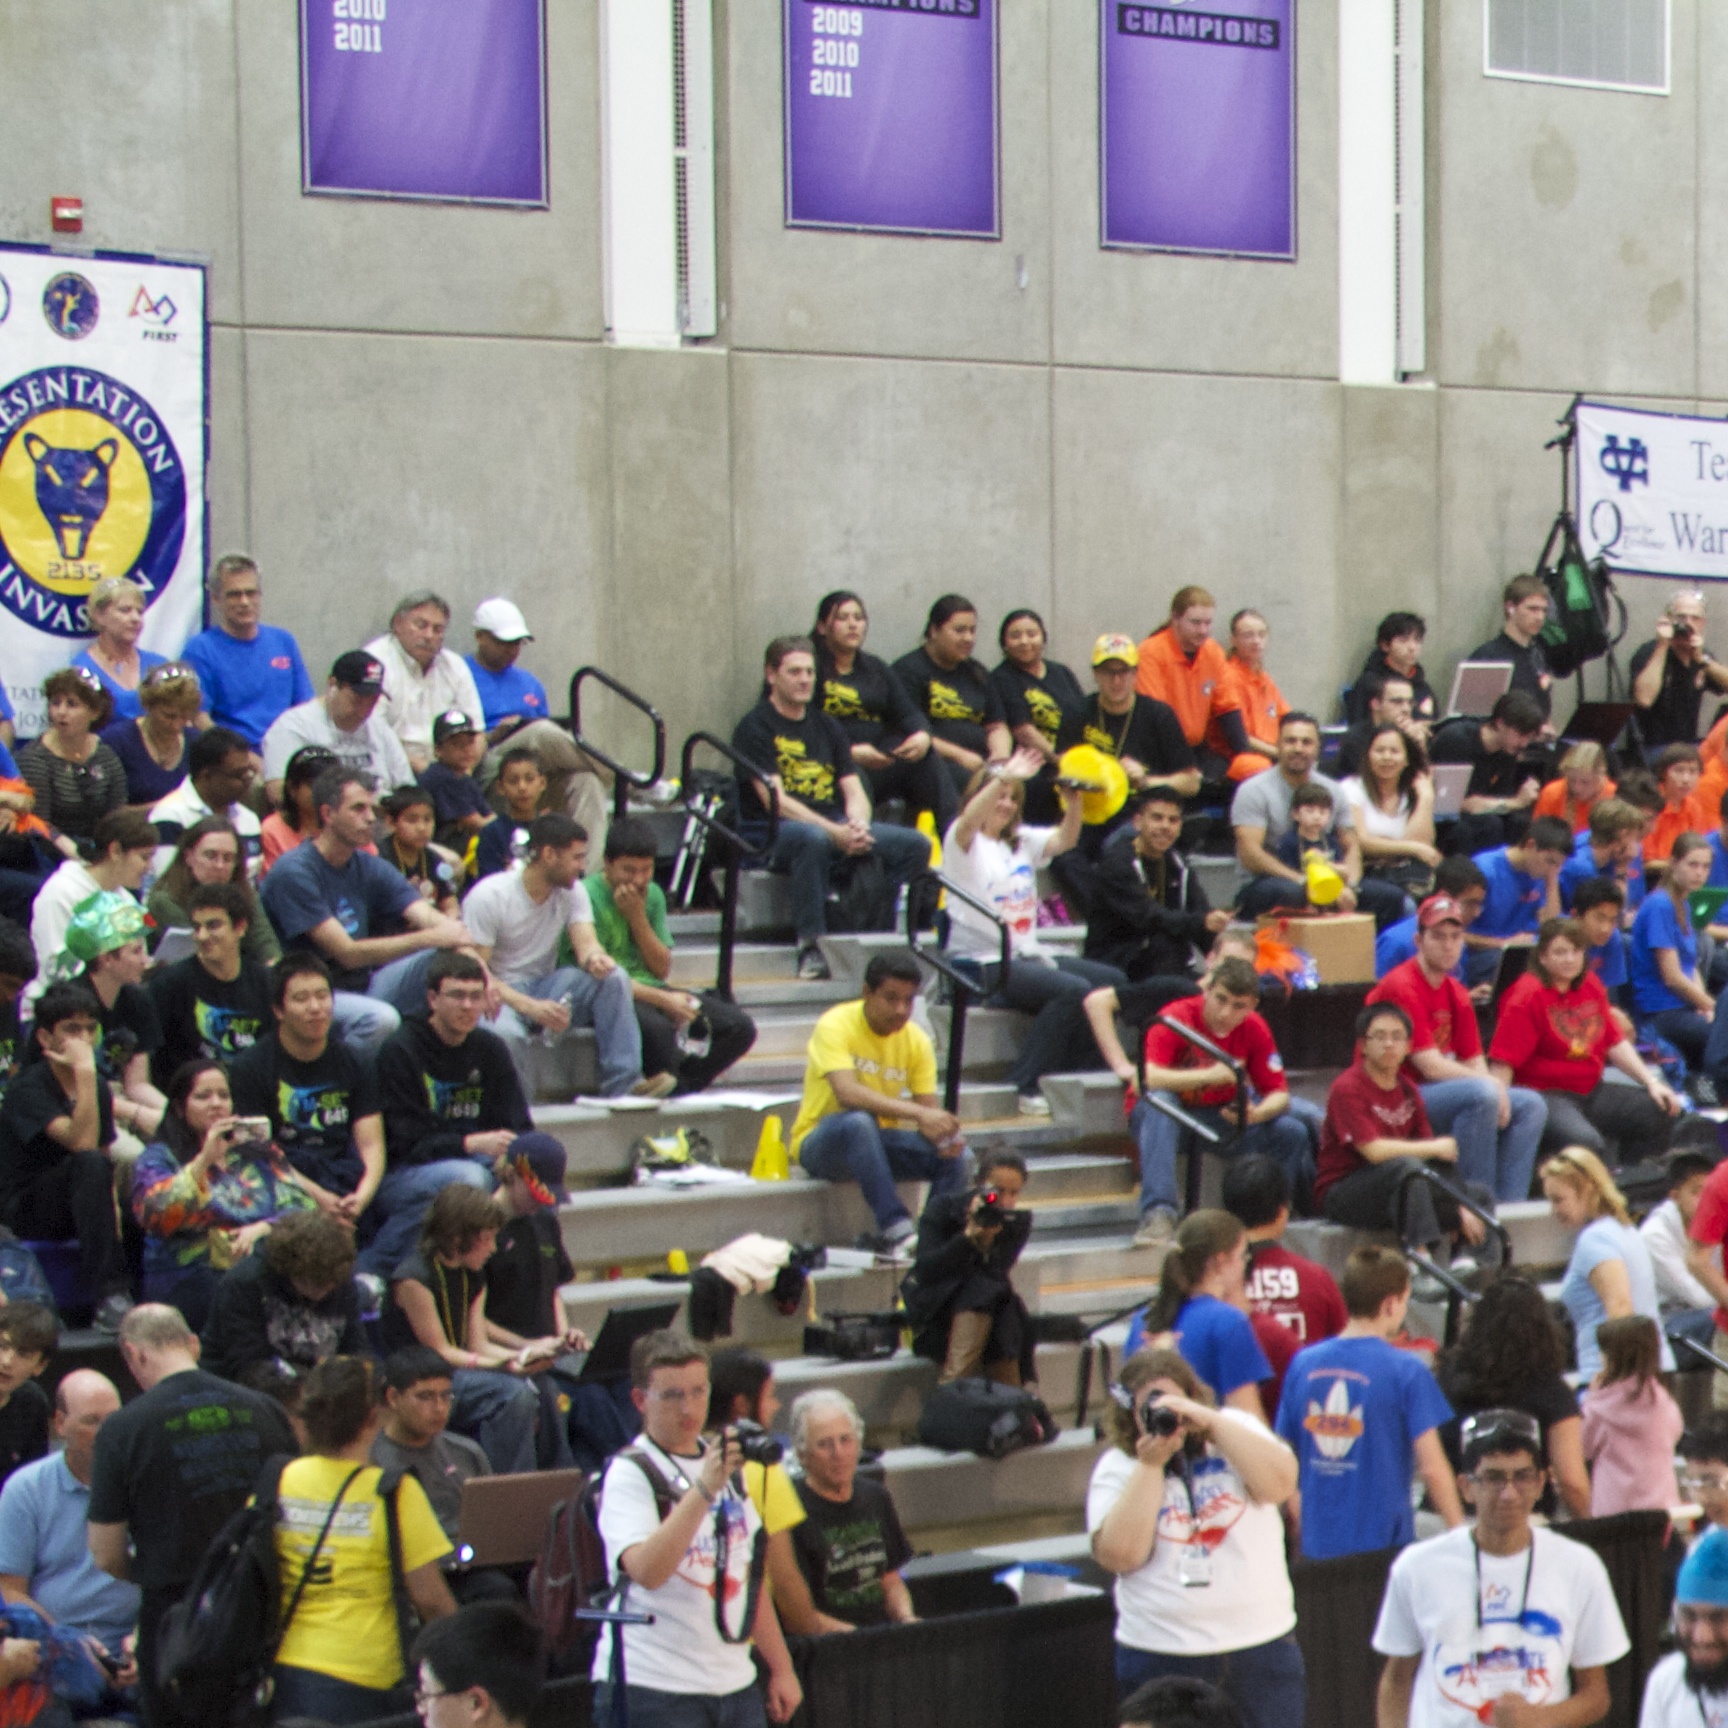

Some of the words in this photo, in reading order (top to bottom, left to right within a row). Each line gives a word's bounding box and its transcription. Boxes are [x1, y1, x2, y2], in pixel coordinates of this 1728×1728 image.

[812, 9, 862, 36] 2009
[1126, 9, 1274, 46] CHAMPIONS
[334, 23, 383, 53] 2011
[813, 39, 859, 67] 2010
[810, 70, 852, 97] 2011
[47, 561, 102, 581] 2135
